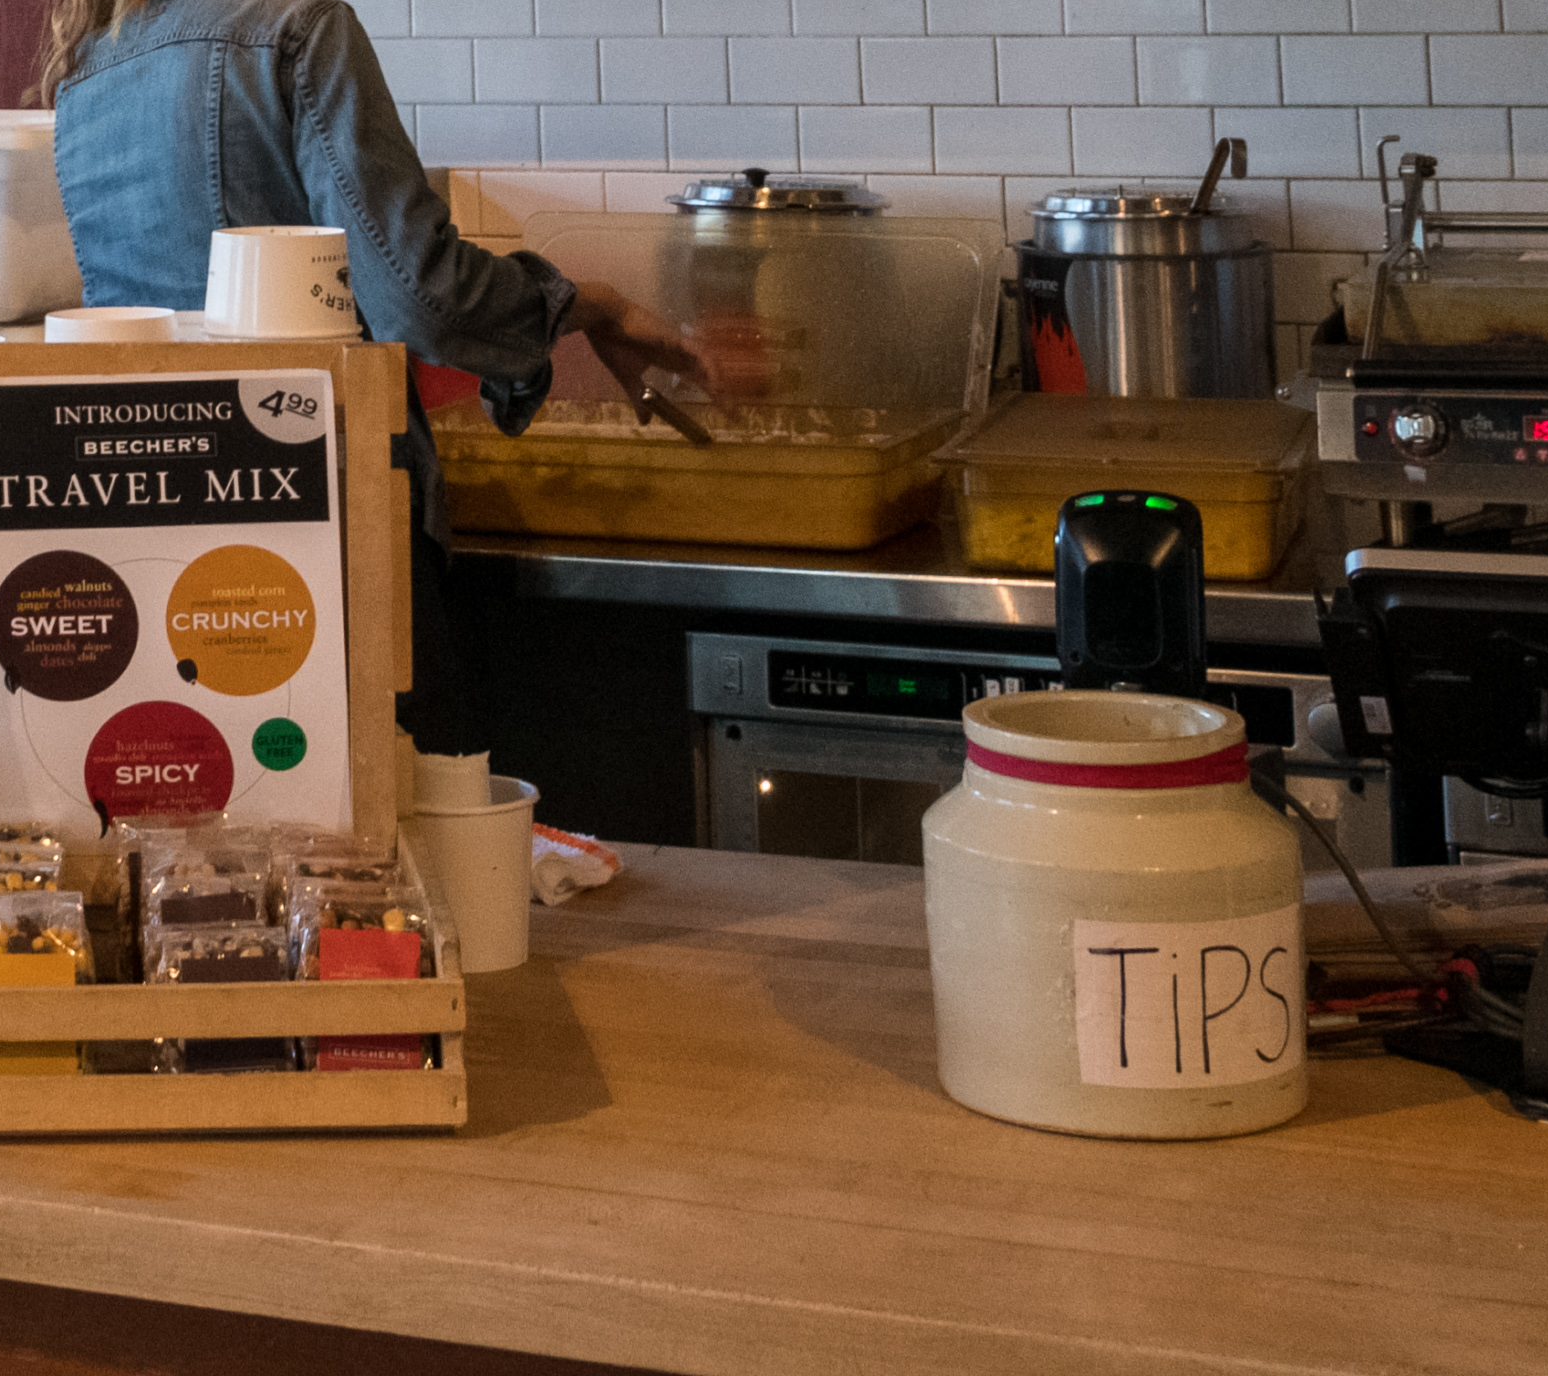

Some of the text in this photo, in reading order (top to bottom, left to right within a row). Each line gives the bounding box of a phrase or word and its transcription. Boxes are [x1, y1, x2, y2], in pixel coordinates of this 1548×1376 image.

[54, 401, 233, 425] INTRODUCING
[83, 436, 210, 455] BEECHER'S
[204, 467, 301, 502] MIX
[64, 579, 113, 592] walnuts
[11, 614, 113, 636] SWEET
[172, 610, 307, 631] CRUNCHY
[256, 735, 304, 746] GLUTEN
[267, 748, 294, 757] FREE
[116, 764, 199, 784] SPICY
